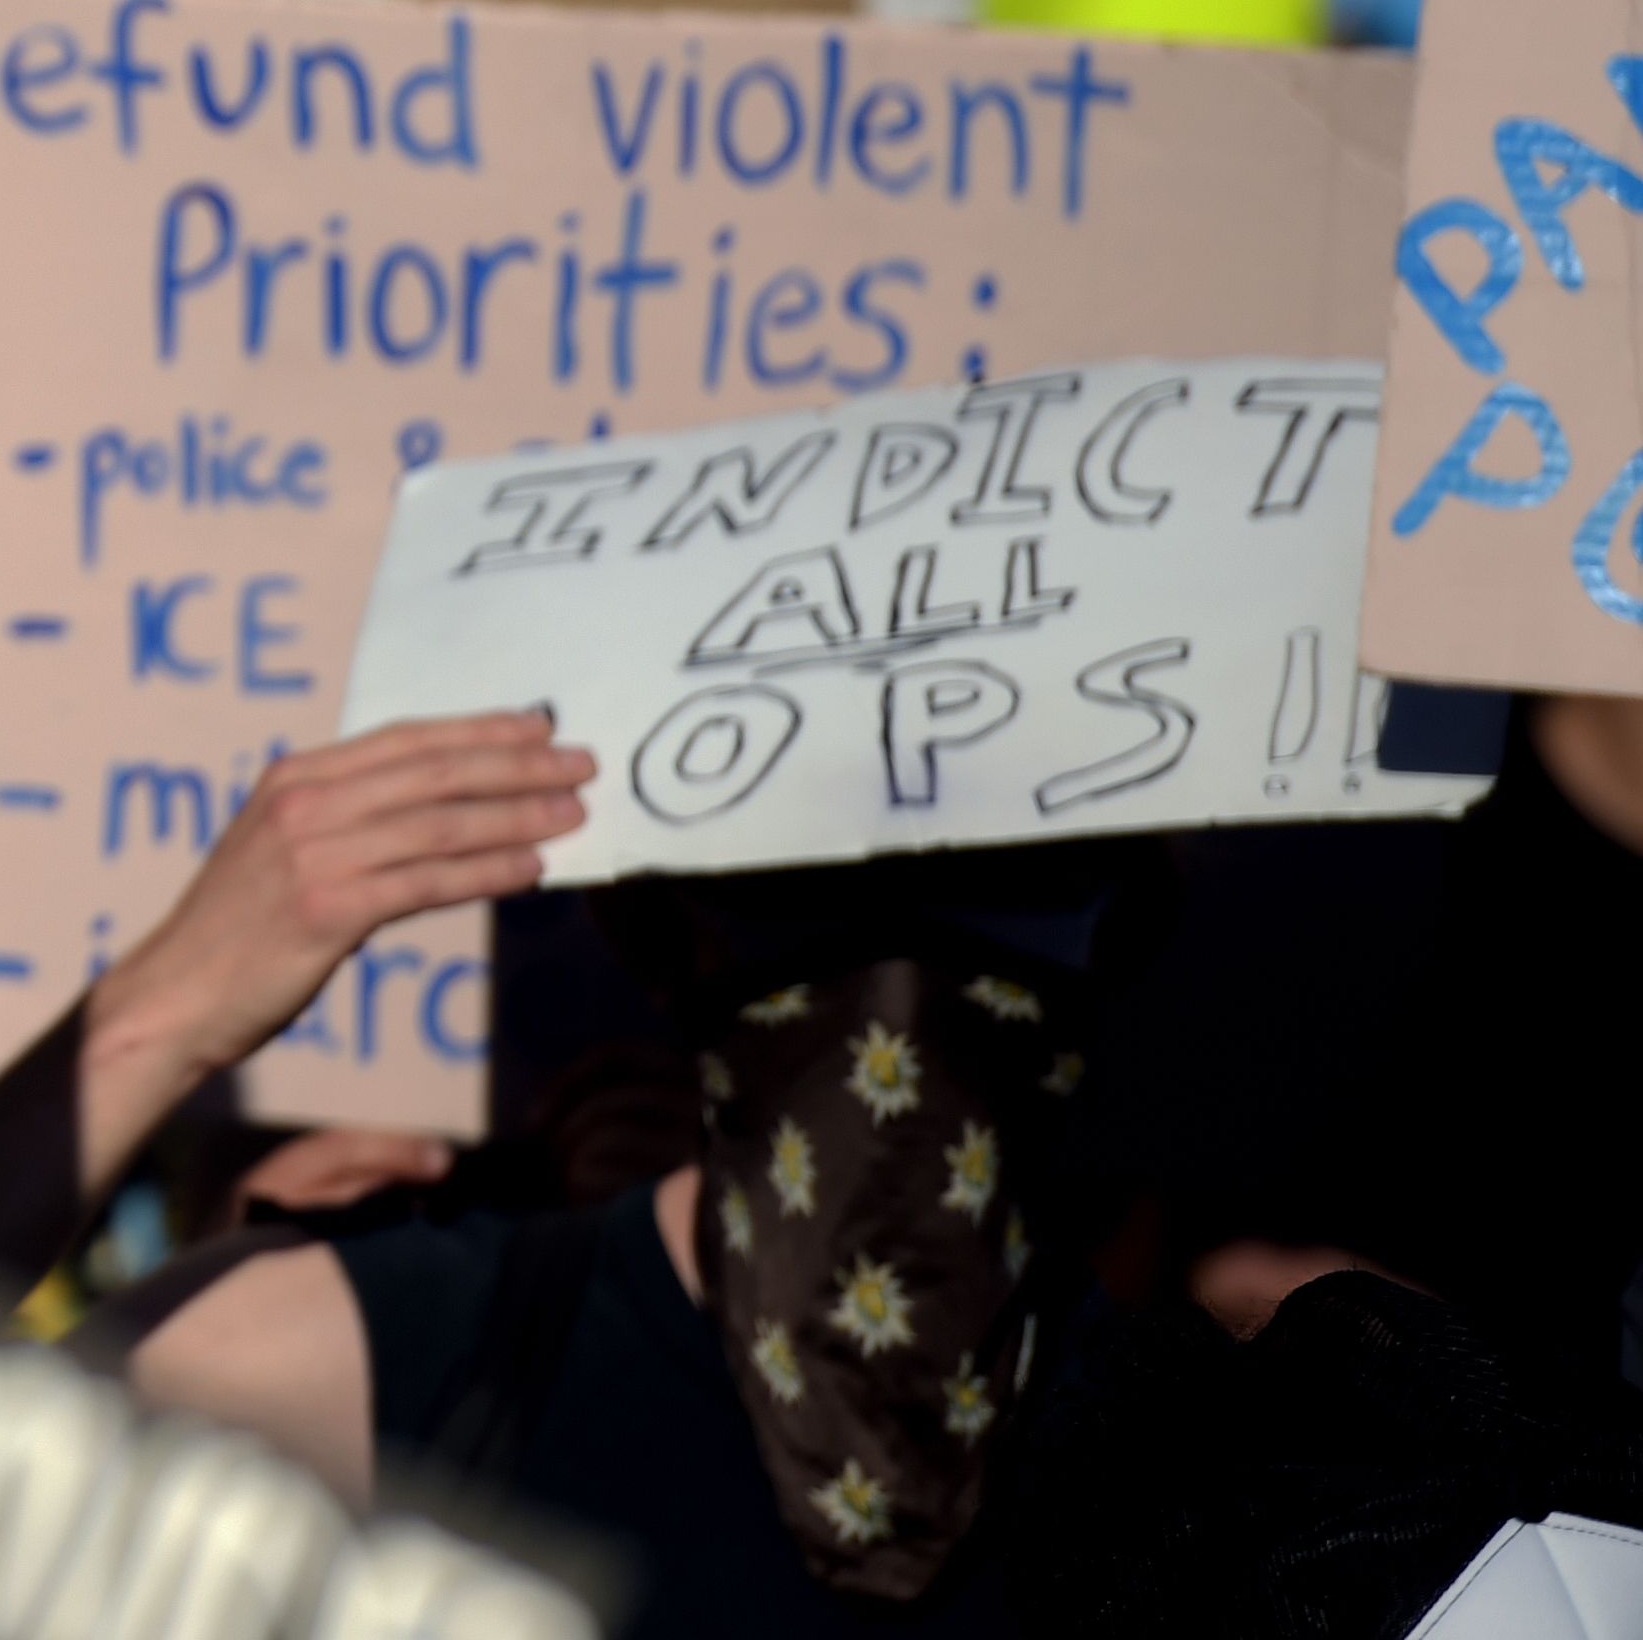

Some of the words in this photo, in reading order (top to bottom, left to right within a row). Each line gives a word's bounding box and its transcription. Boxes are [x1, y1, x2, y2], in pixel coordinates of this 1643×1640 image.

[590, 30, 1130, 220] violent
[152, 180, 999, 393] Priorities:
[78, 413, 327, 566] police
[450, 370, 1380, 577] INDICT
[127, 574, 319, 695] ICE
[681, 538, 1078, 668] ALL
